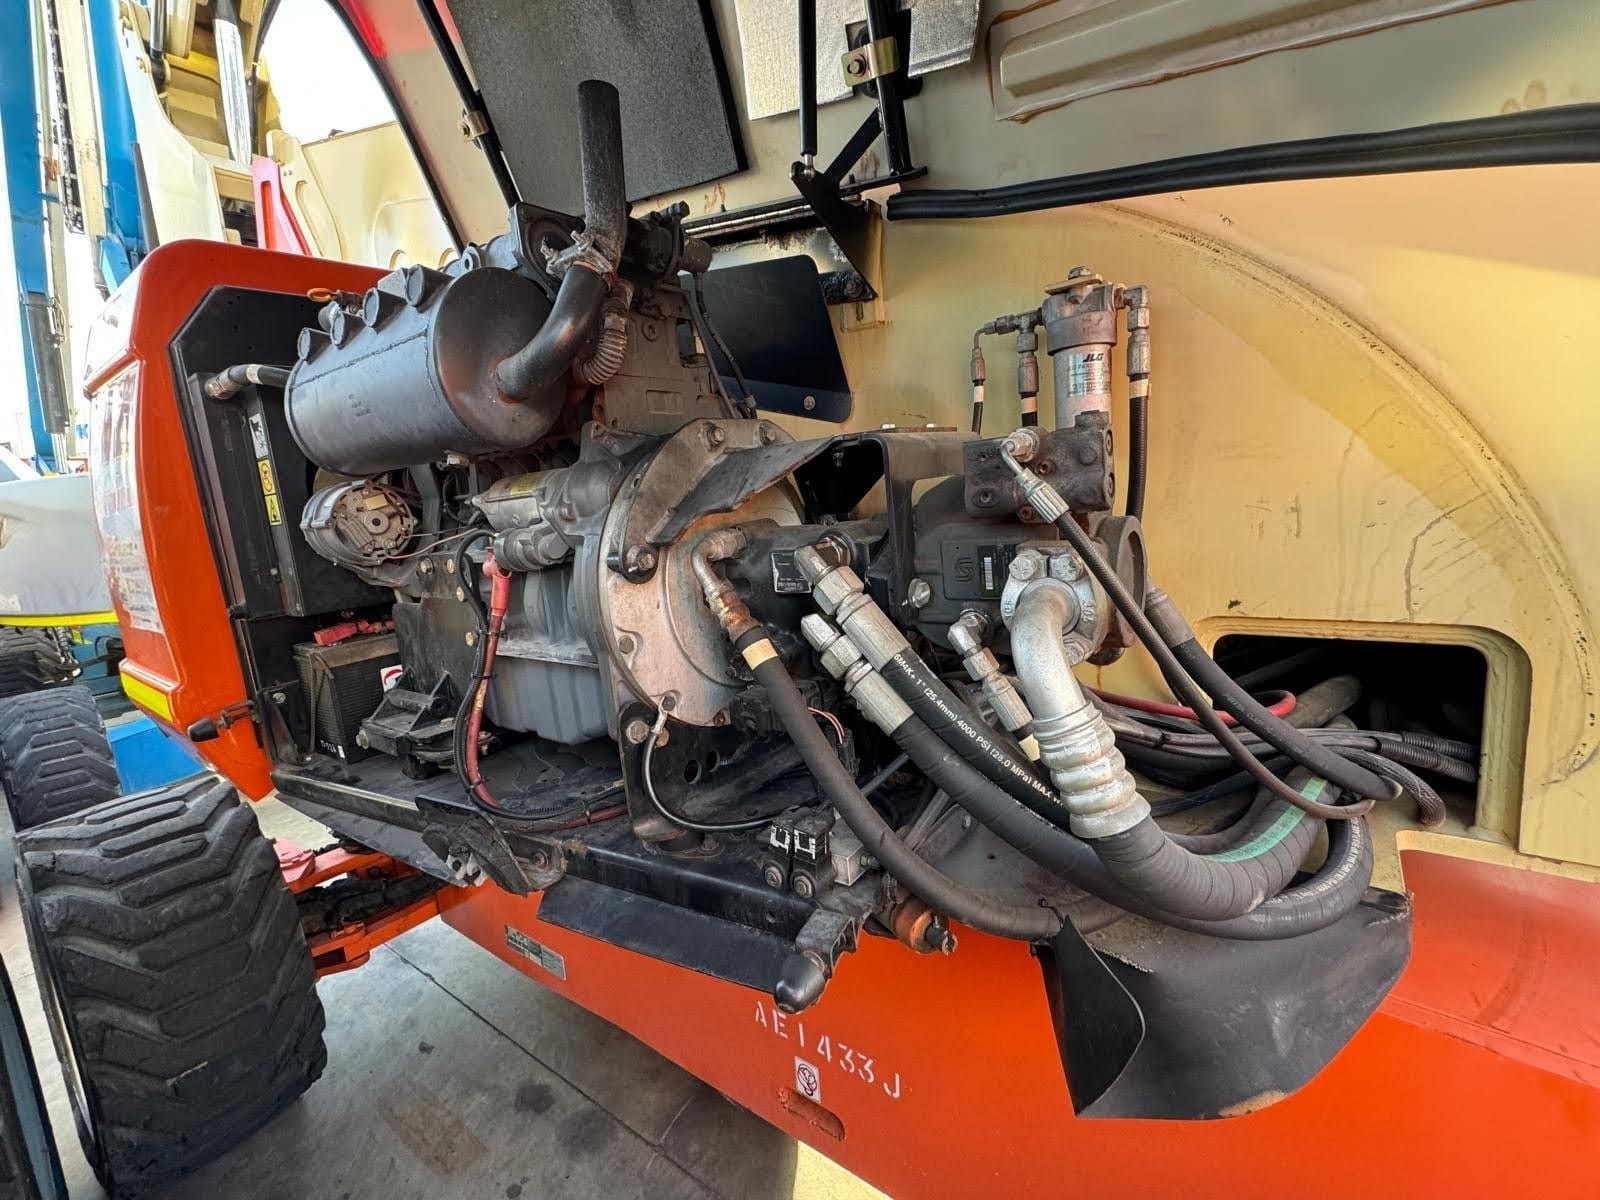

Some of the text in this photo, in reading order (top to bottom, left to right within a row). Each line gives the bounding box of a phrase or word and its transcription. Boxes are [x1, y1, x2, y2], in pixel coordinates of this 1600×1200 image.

[1083, 353, 1104, 363] JLG
[923, 686, 959, 722] (25.4mm)
[956, 719, 978, 739] 4000
[975, 735, 992, 752] PSI
[1009, 763, 1033, 786] MPa)
[1031, 780, 1053, 799] MAX
